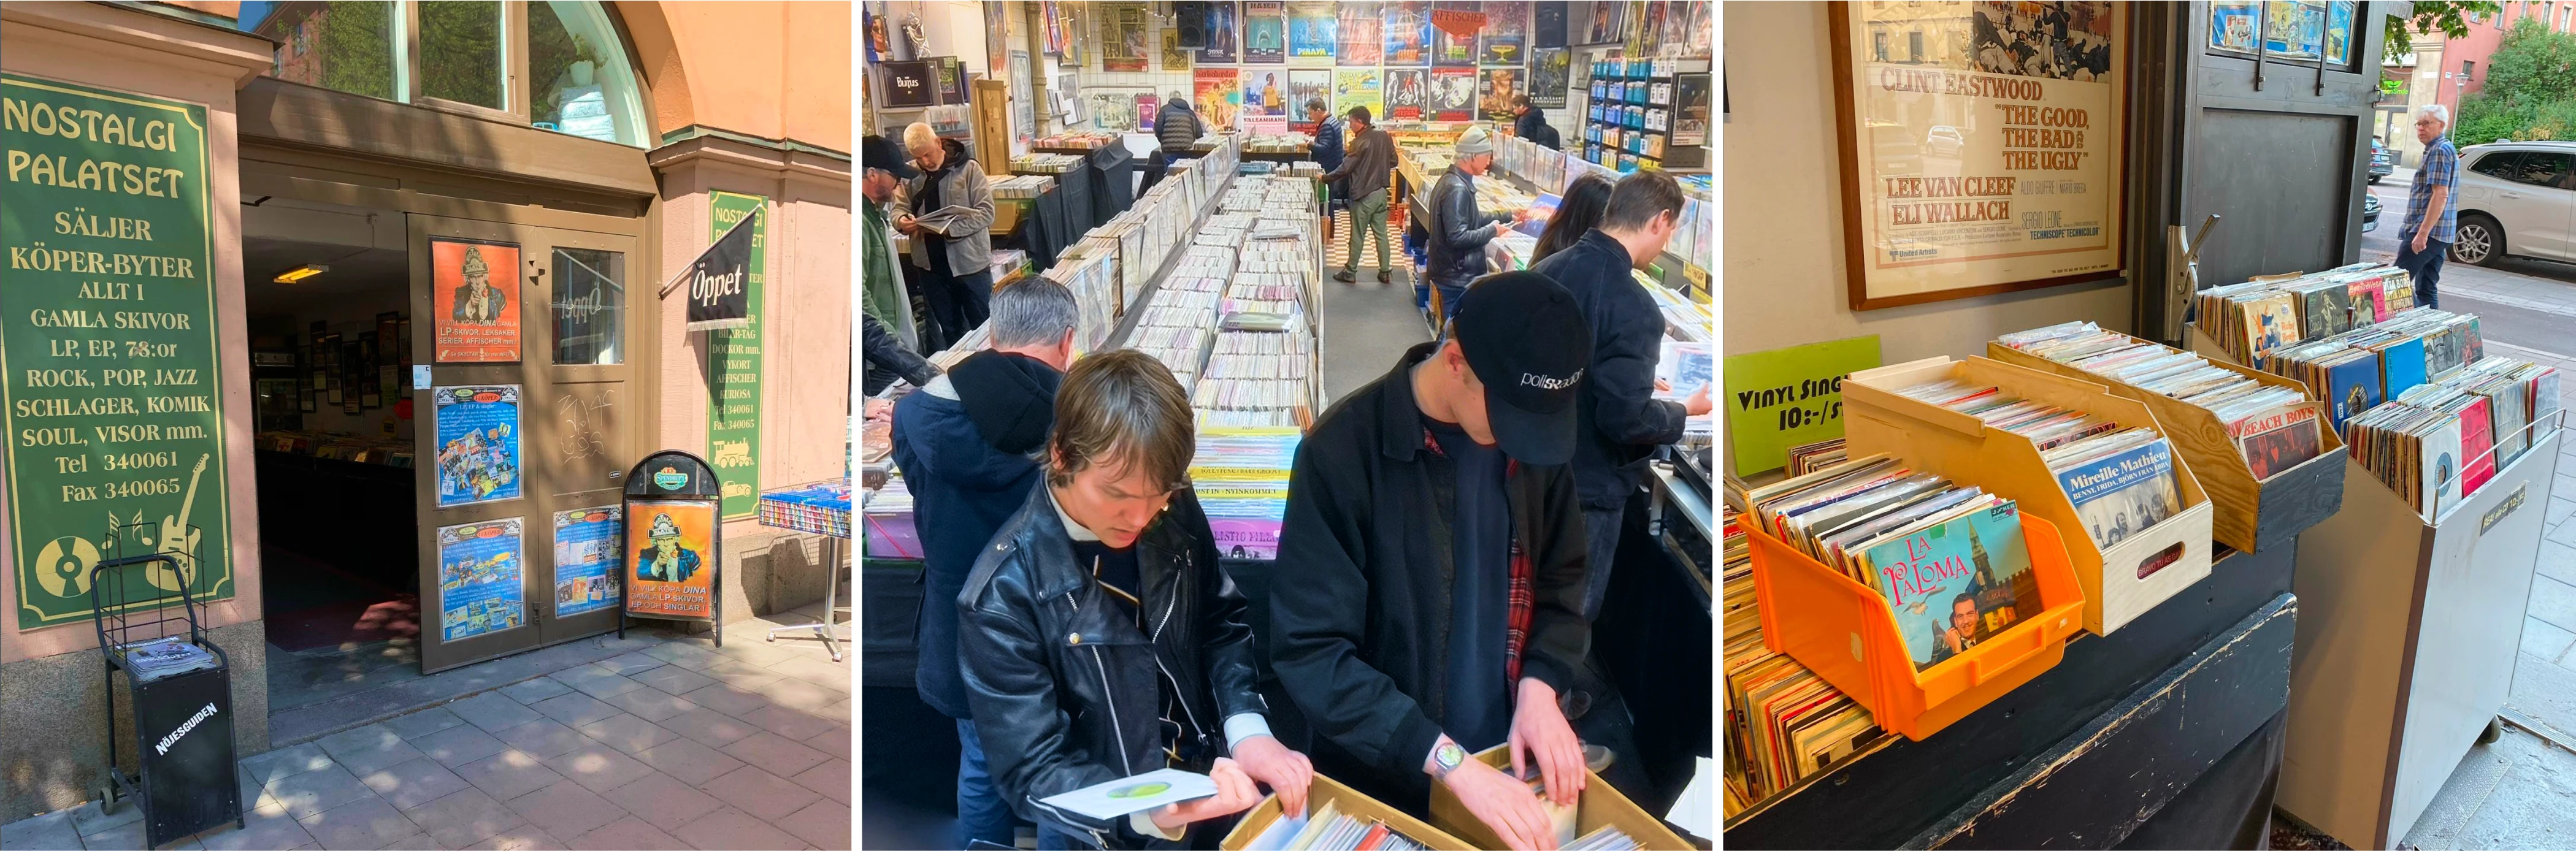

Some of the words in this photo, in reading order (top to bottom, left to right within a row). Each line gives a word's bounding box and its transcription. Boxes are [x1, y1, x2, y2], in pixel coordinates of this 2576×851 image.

[1881, 67, 1940, 94] CLINT
[1944, 72, 2043, 101] EASTWOOD
[3, 97, 177, 152] NOSTALGI
[2041, 106, 2090, 130] GOOD,
[2002, 128, 2038, 148] THE
[2041, 129, 2075, 148] BAD
[2003, 151, 2038, 170] THE
[8, 150, 183, 199] PALATSET
[1886, 177, 1922, 199] LEE
[1923, 176, 1963, 197] VAN
[1965, 176, 2017, 197] CLEEF
[2020, 181, 2034, 195] ALDO
[2060, 183, 2072, 194] MARIO
[715, 207, 763, 228] NOSTGI
[1892, 204, 1922, 225] ELI
[1924, 200, 2010, 223] WALLACH
[2022, 212, 2043, 230] SERGIO
[2044, 210, 2062, 229] LEONE
[55, 207, 153, 241] SÄLJER
[2030, 229, 2066, 240] TECHNISCOPE
[2066, 227, 2100, 237] TECHNICOLOR
[10, 242, 195, 278] KÖPER-BYTER
[78, 281, 130, 300] ALLT
[137, 284, 144, 300] I
[692, 262, 743, 307] Öppet
[31, 308, 109, 329] GAMLA
[115, 311, 191, 330] SKIVOR
[2281, 320, 2295, 331] Ruby
[718, 328, 756, 339] BILAR-TÅG
[51, 340, 80, 360] LP,
[89, 340, 117, 359] EP,
[712, 343, 743, 354] DOCKOR
[722, 359, 751, 370] VYKORT
[27, 369, 95, 389] ROCK,
[103, 369, 147, 387] POP,
[154, 368, 198, 386] JAZZ
[716, 373, 756, 384] AFFISCHER
[719, 389, 751, 400] KURIOSA
[16, 397, 139, 418] SCHLAGER,
[147, 396, 210, 413] KOMIK
[715, 405, 726, 415] Tel
[727, 404, 754, 414] 340061
[713, 421, 726, 430] Fax
[728, 419, 754, 430] 340065
[2243, 414, 2283, 437] BEACH
[2285, 406, 2315, 425] BOYS
[22, 427, 88, 448] SOUL,
[94, 424, 161, 443] VISOR
[166, 425, 208, 440] mm.
[55, 454, 87, 474] Tel
[104, 451, 178, 471] 340061
[2070, 466, 2120, 492] Mireille
[2120, 451, 2167, 475] Mathieu
[62, 483, 98, 502] Fax
[105, 478, 180, 499] 340065
[2072, 486, 2097, 500] BENNY,
[2096, 479, 2118, 494] FRIDA,
[2118, 471, 2139, 486] BJÖRN
[2138, 466, 2154, 478] FRÅN
[2153, 461, 2169, 472] ABBA
[1905, 536, 1932, 563] LA
[2138, 562, 2156, 577] BRAVO
[2156, 559, 2164, 568] TU
[2164, 555, 2171, 565] AS
[659, 584, 681, 593] KÖPA
[683, 586, 707, 594] DINA
[1883, 554, 1970, 608] PALOMA
[664, 602, 701, 612] SINGLAR
[155, 702, 218, 756] NÖJESGUIDEN
